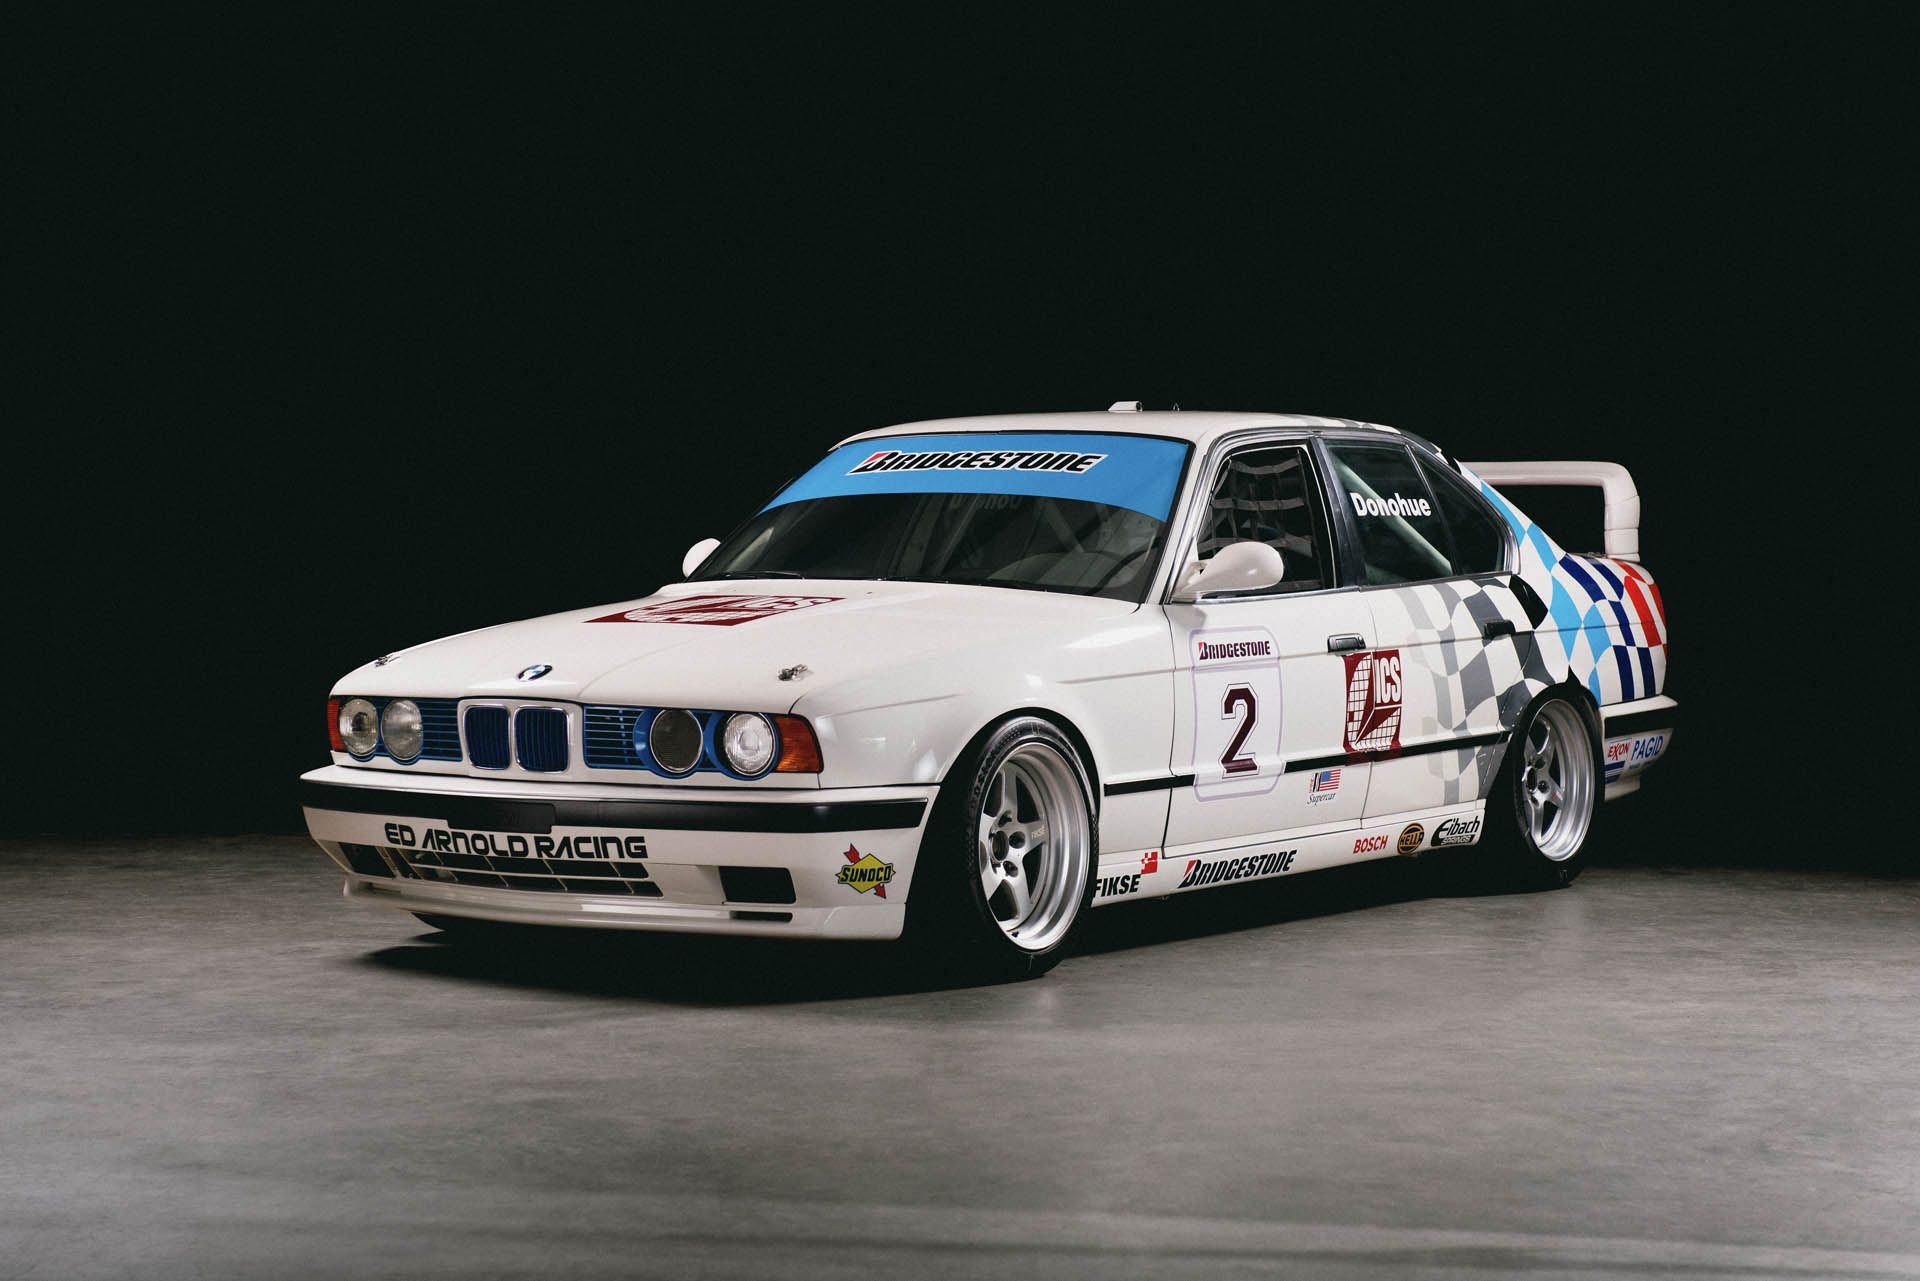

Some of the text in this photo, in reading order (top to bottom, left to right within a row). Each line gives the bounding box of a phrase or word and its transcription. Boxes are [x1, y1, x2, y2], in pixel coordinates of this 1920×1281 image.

[849, 451, 1103, 473] BRIDGESTONE
[1350, 492, 1432, 517] Donohue
[1198, 640, 1271, 660] BRIDGESTONE
[1374, 656, 1401, 704] ICS
[1220, 685, 1258, 776] 2
[1607, 742, 1631, 761] EXXON
[1631, 735, 1664, 761] PAGID
[1306, 792, 1336, 806] Supercar
[384, 822, 649, 859] ED ARNOLD RACING
[1400, 831, 1424, 847] HELLA
[1431, 816, 1481, 846] Eibach
[1353, 835, 1389, 854] BOSCH
[840, 866, 892, 882] SUNOCO
[1177, 850, 1298, 889] BRIDGESTONE
[1093, 874, 1142, 899] FIKSE
